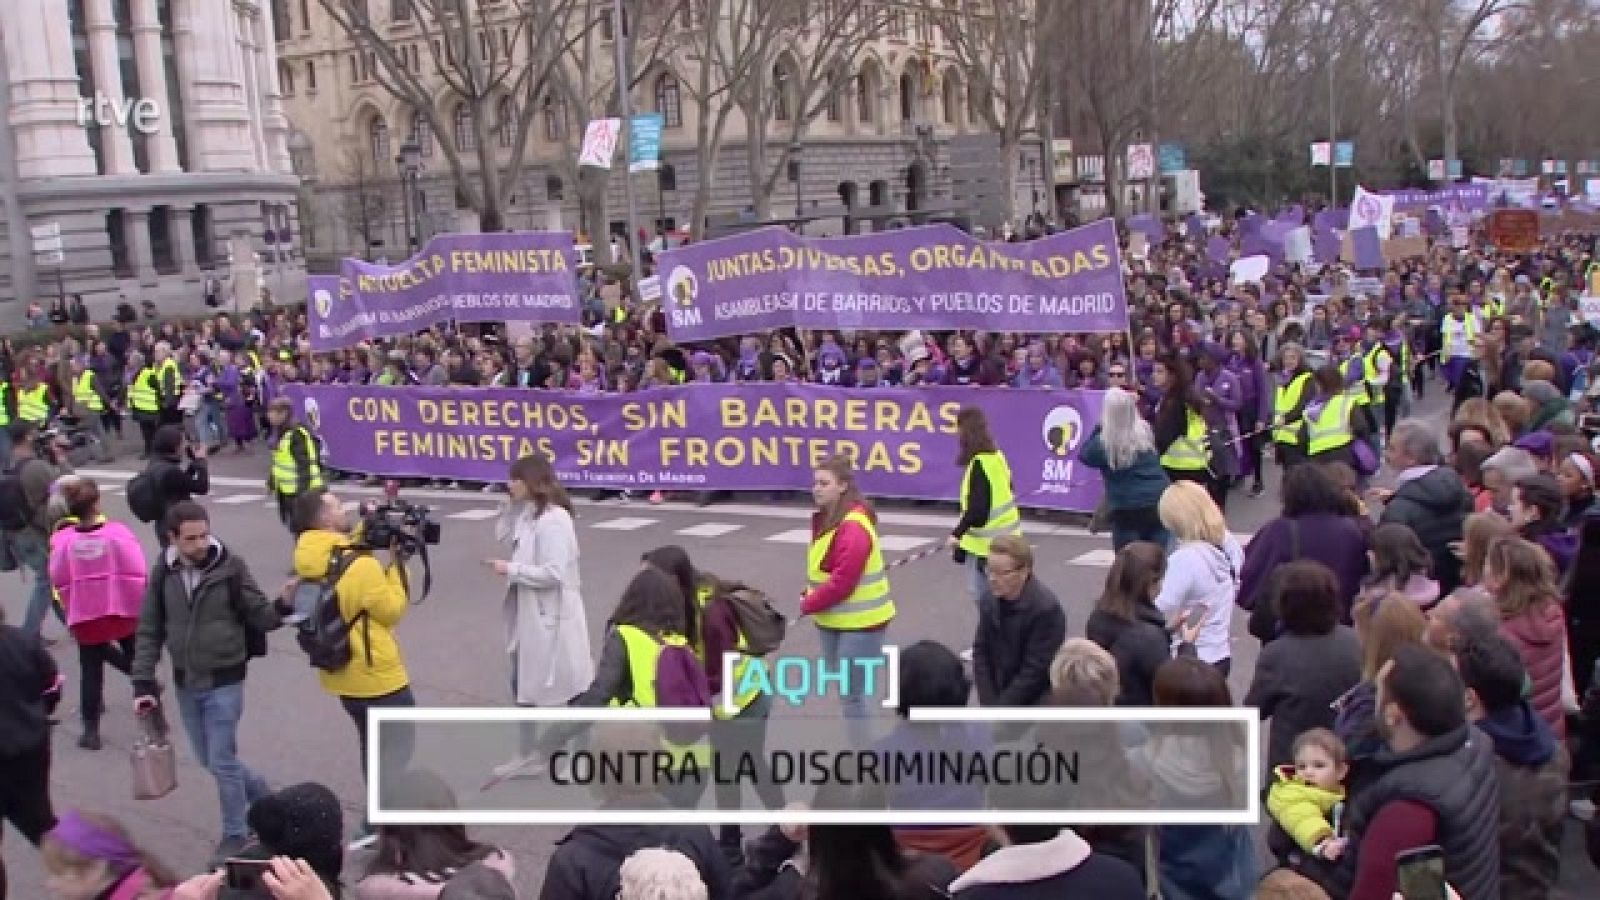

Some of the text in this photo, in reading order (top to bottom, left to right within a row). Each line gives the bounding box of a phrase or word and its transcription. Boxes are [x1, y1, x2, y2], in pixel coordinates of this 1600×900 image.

[452, 250, 568, 273] FEMINISTA
[909, 245, 1111, 278] ORGANADAS
[804, 292, 828, 311] DE
[1009, 293, 1035, 314] DE
[1039, 291, 1116, 316] MADRID
[349, 396, 961, 435] CON DERECHOS, SIN BARRERAS
[374, 430, 922, 474] FEMINISTAS SIN FRONTERAS
